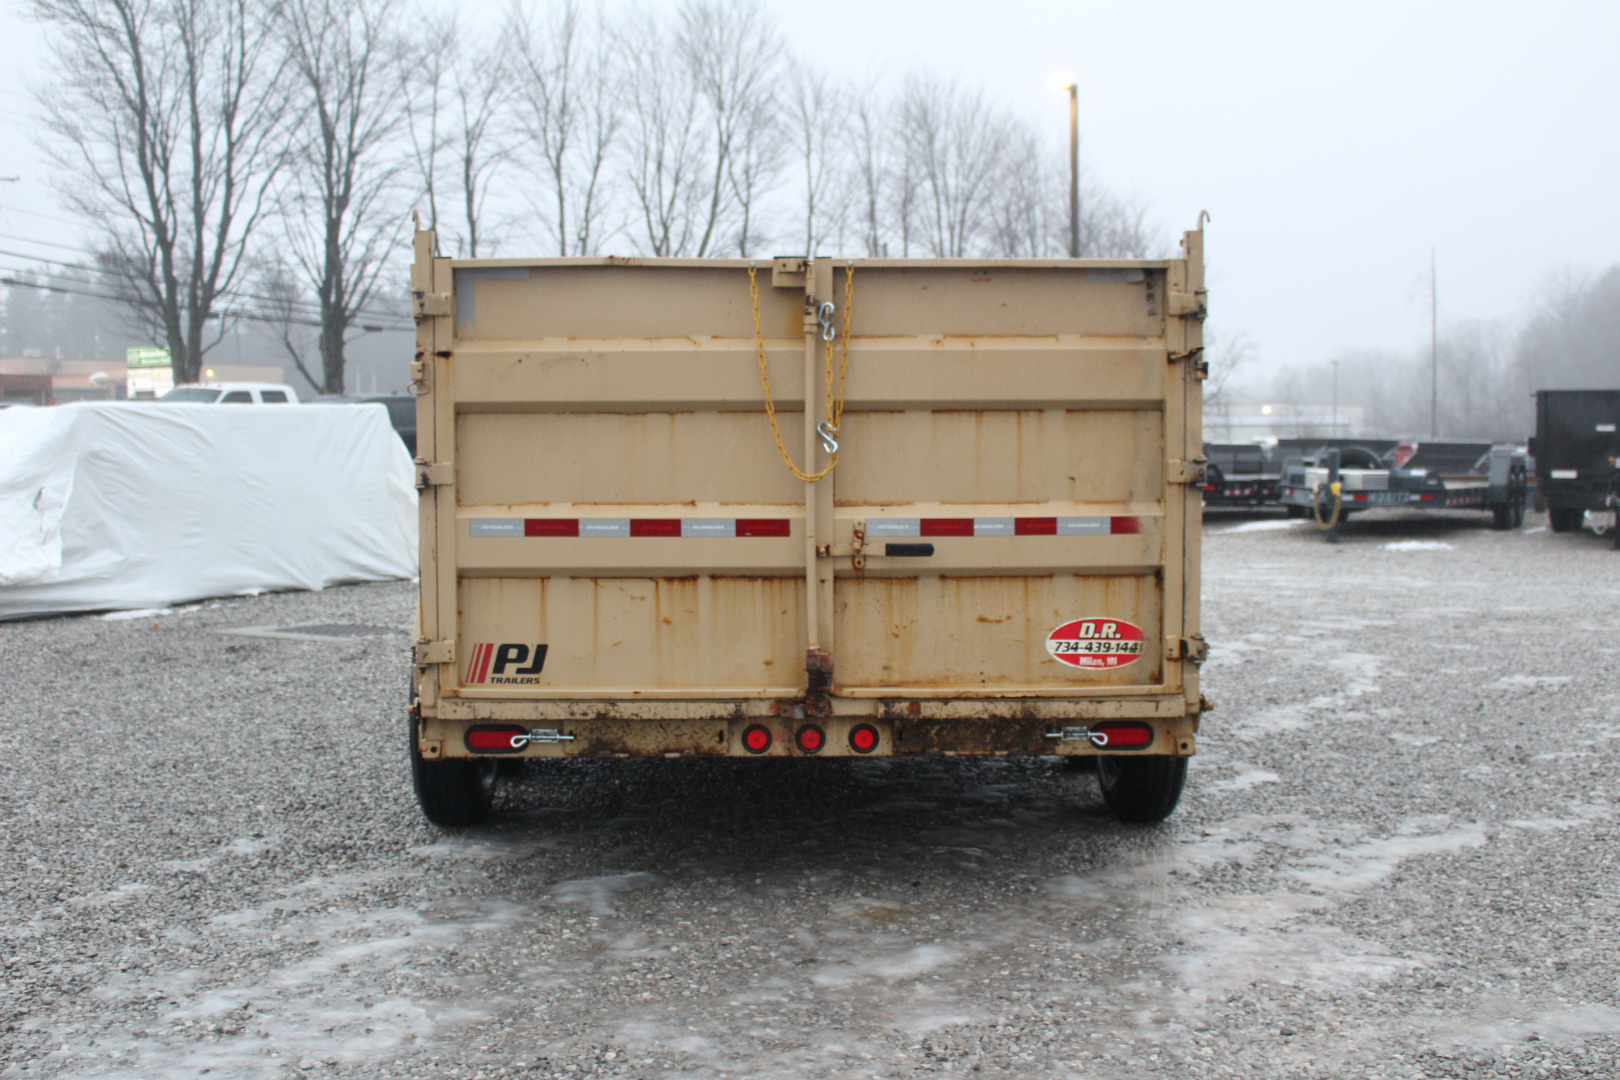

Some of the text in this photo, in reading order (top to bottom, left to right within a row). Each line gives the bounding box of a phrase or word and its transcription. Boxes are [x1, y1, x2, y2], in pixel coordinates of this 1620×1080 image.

[1078, 621, 1122, 639] D.R.
[492, 643, 549, 675] PJ
[1106, 656, 1118, 666] MI
